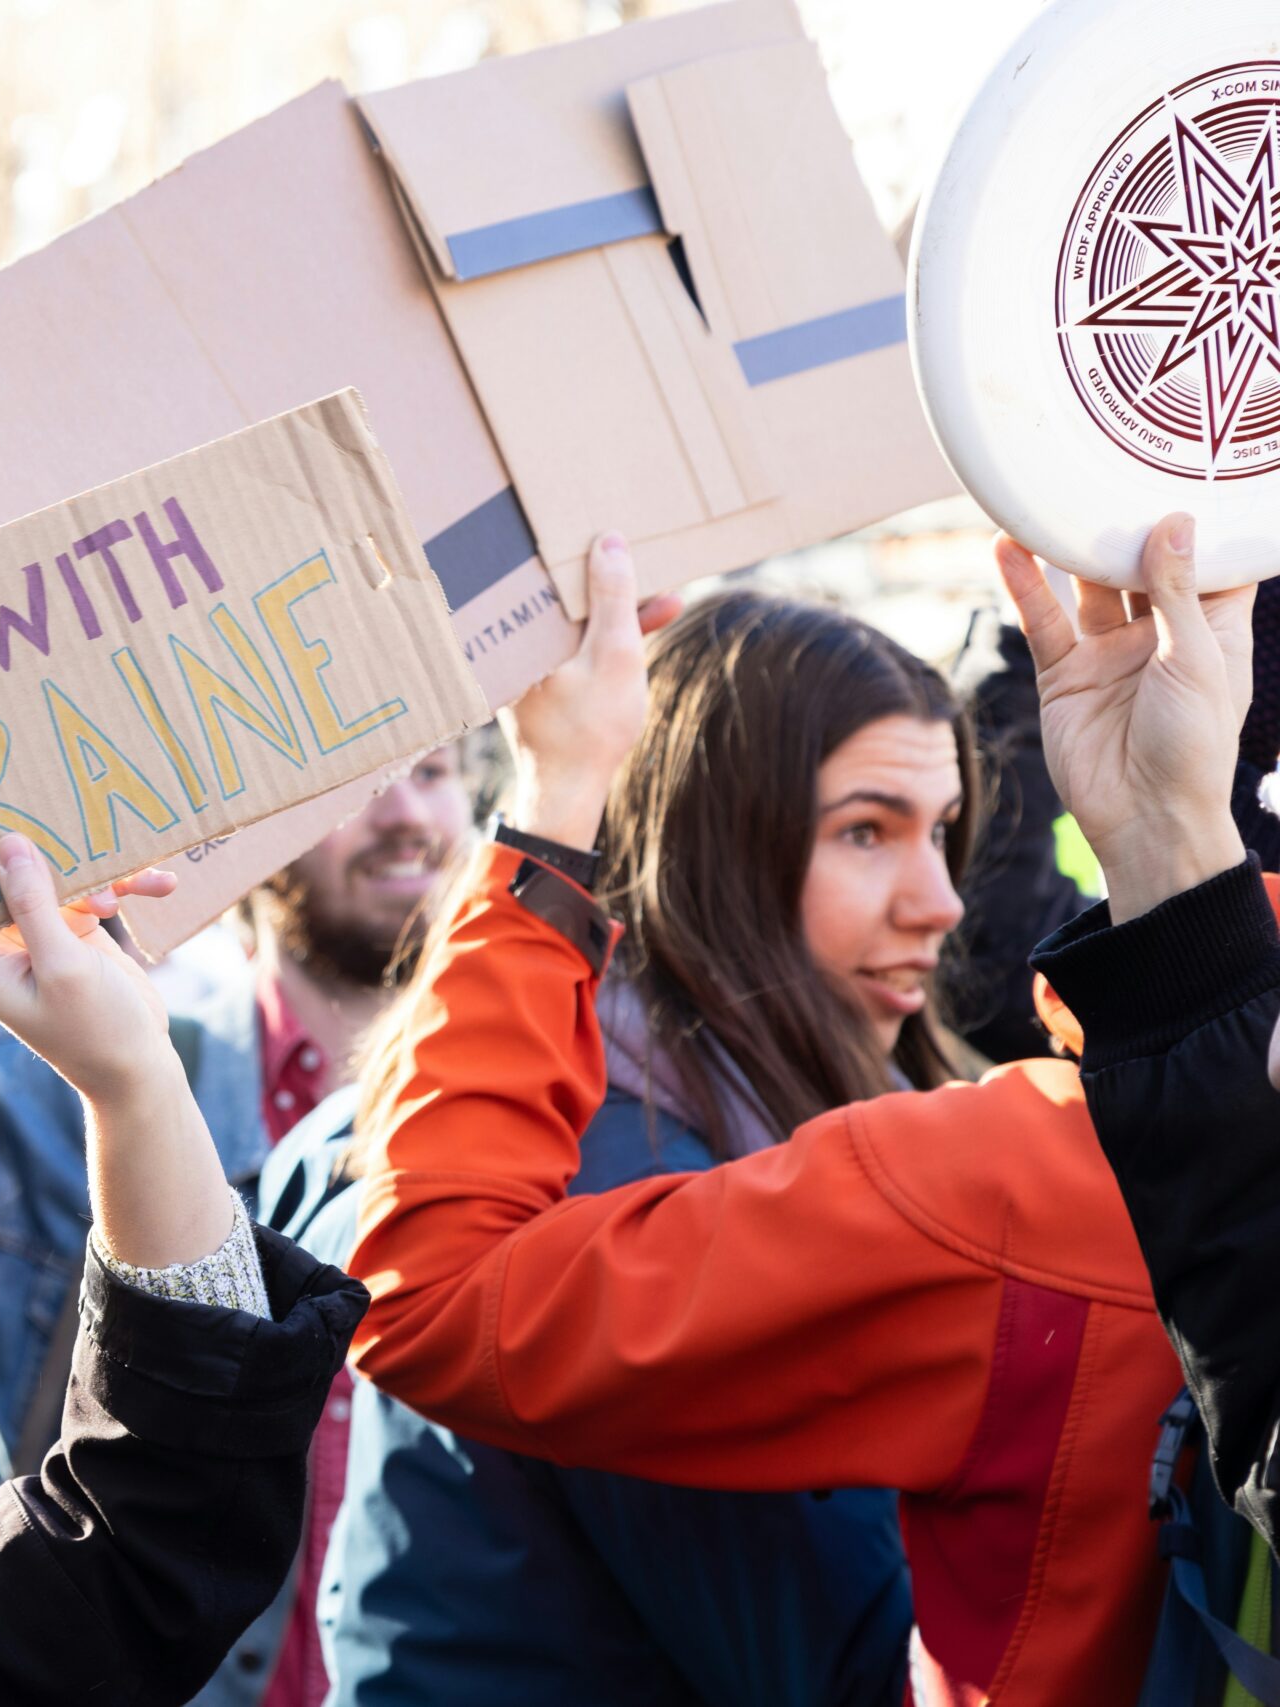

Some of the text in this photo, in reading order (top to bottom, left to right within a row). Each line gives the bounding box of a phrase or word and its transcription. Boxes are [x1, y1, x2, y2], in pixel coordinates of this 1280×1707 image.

[1212, 81, 1256, 101] X-COM
[1073, 153, 1133, 280] WFDF APPROVED
[1088, 367, 1173, 453] USAU APPROVED
[1233, 446, 1261, 459] DISC
